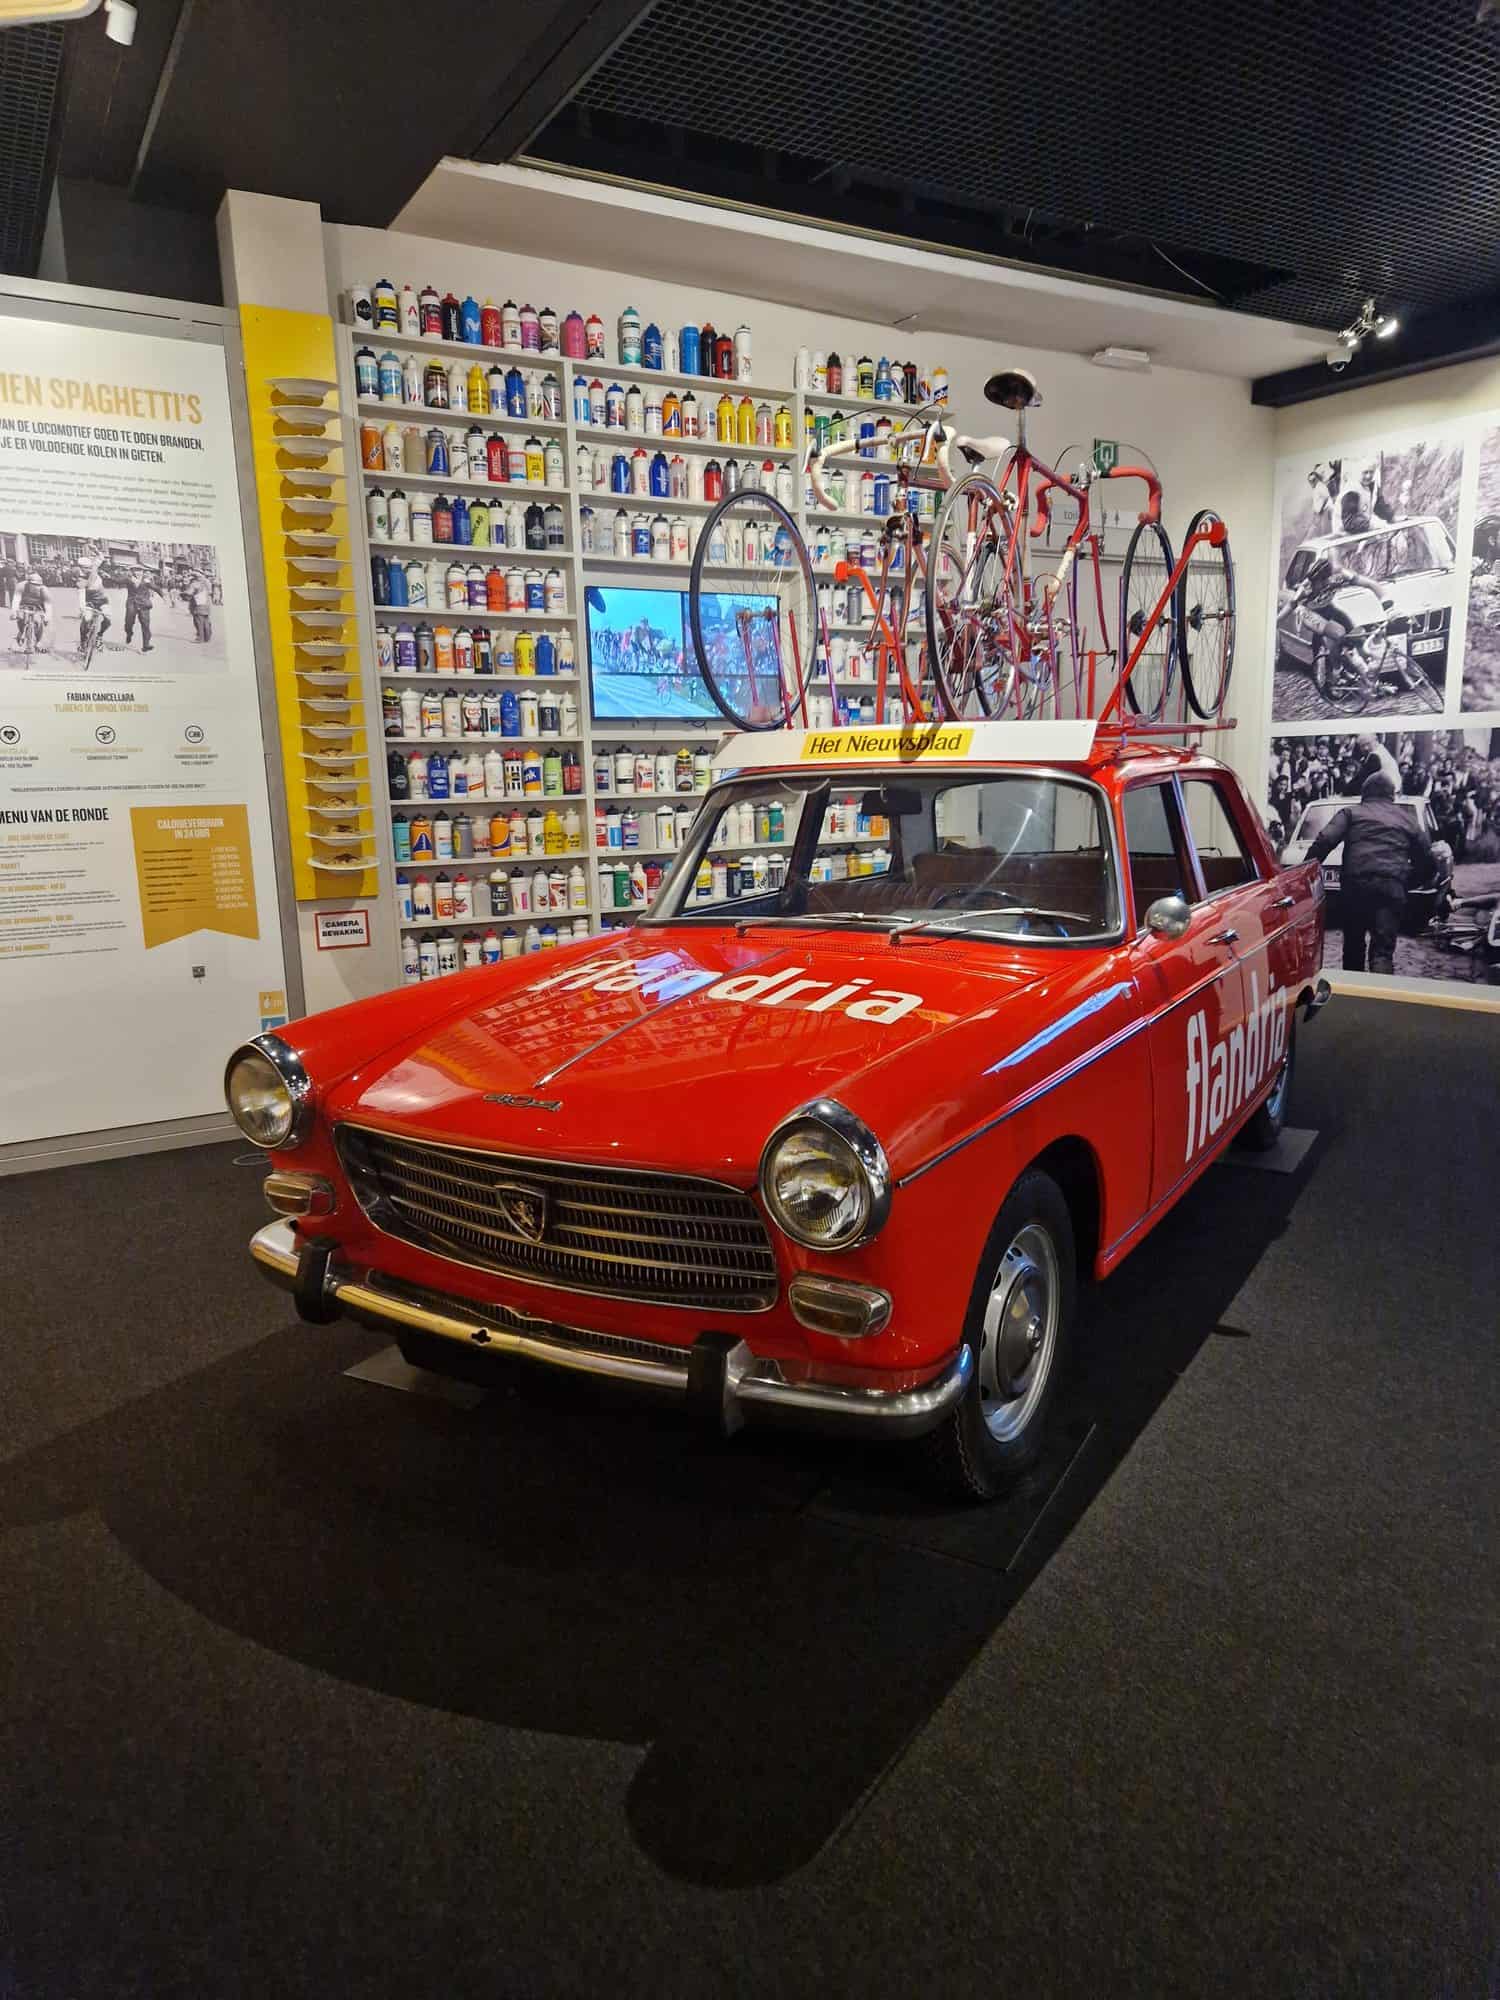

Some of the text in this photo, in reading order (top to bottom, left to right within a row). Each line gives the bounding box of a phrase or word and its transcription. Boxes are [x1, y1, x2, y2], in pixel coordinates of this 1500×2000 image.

[49, 377, 203, 424] SPAGHETTI'S
[18, 420, 30, 433] DE
[32, 422, 92, 439] LOCOMOTIEF
[94, 427, 118, 442] GOED
[120, 430, 132, 443] TE
[133, 432, 158, 446] DOEN
[160, 435, 204, 452] BRANDEN,
[1, 437, 166, 463] JE ER VOLDOENDE KOLEN IN GIETEN.
[66, 692, 135, 702] FABIAN CANCELLARA
[809, 733, 962, 754] Het Nieuwsblad
[30, 809, 53, 823] VAN
[55, 808, 70, 822] DE
[72, 807, 109, 822] RONDE
[322, 928, 364, 937] BEWAKING
[325, 920, 359, 928] CAMERA
[526, 957, 924, 1025] flandria
[1185, 970, 1287, 1163] flandria
